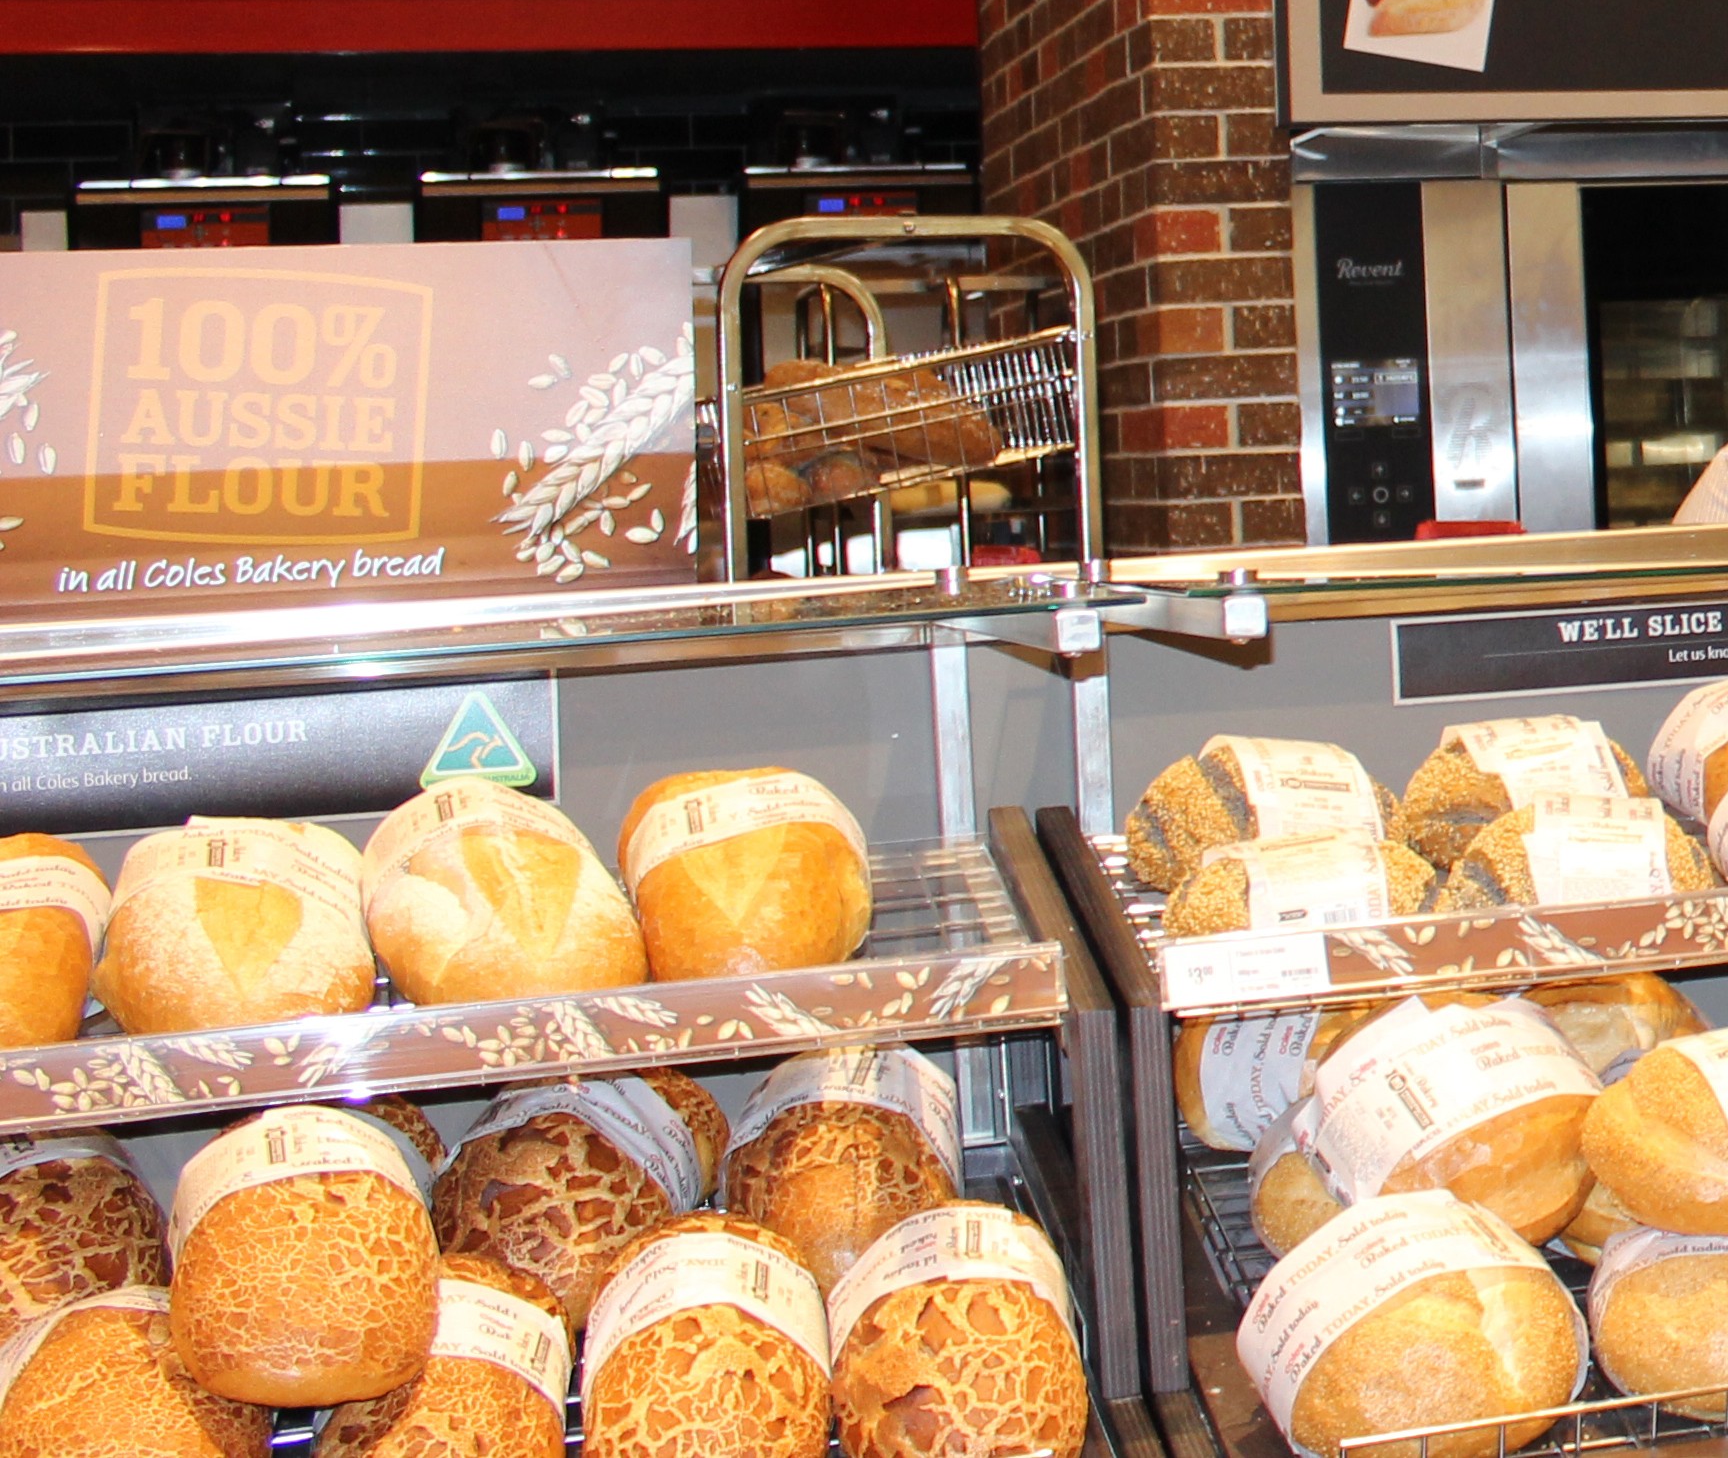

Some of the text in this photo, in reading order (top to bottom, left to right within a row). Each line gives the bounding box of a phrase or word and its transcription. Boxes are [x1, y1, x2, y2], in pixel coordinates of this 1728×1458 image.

[1337, 257, 1403, 279] Revent
[126, 298, 397, 388] 100%
[121, 389, 394, 453] AUSSIE
[113, 454, 389, 518] FLOUR
[58, 546, 445, 593] in all Coles Bakery bread
[1557, 617, 1638, 643] WE'LL
[1648, 611, 1722, 637] SLICE
[1668, 648, 1688, 663] Let
[1691, 649, 1706, 661] us
[202, 720, 308, 748] FLOUR
[12, 766, 192, 791] all Coles Bakery bread.
